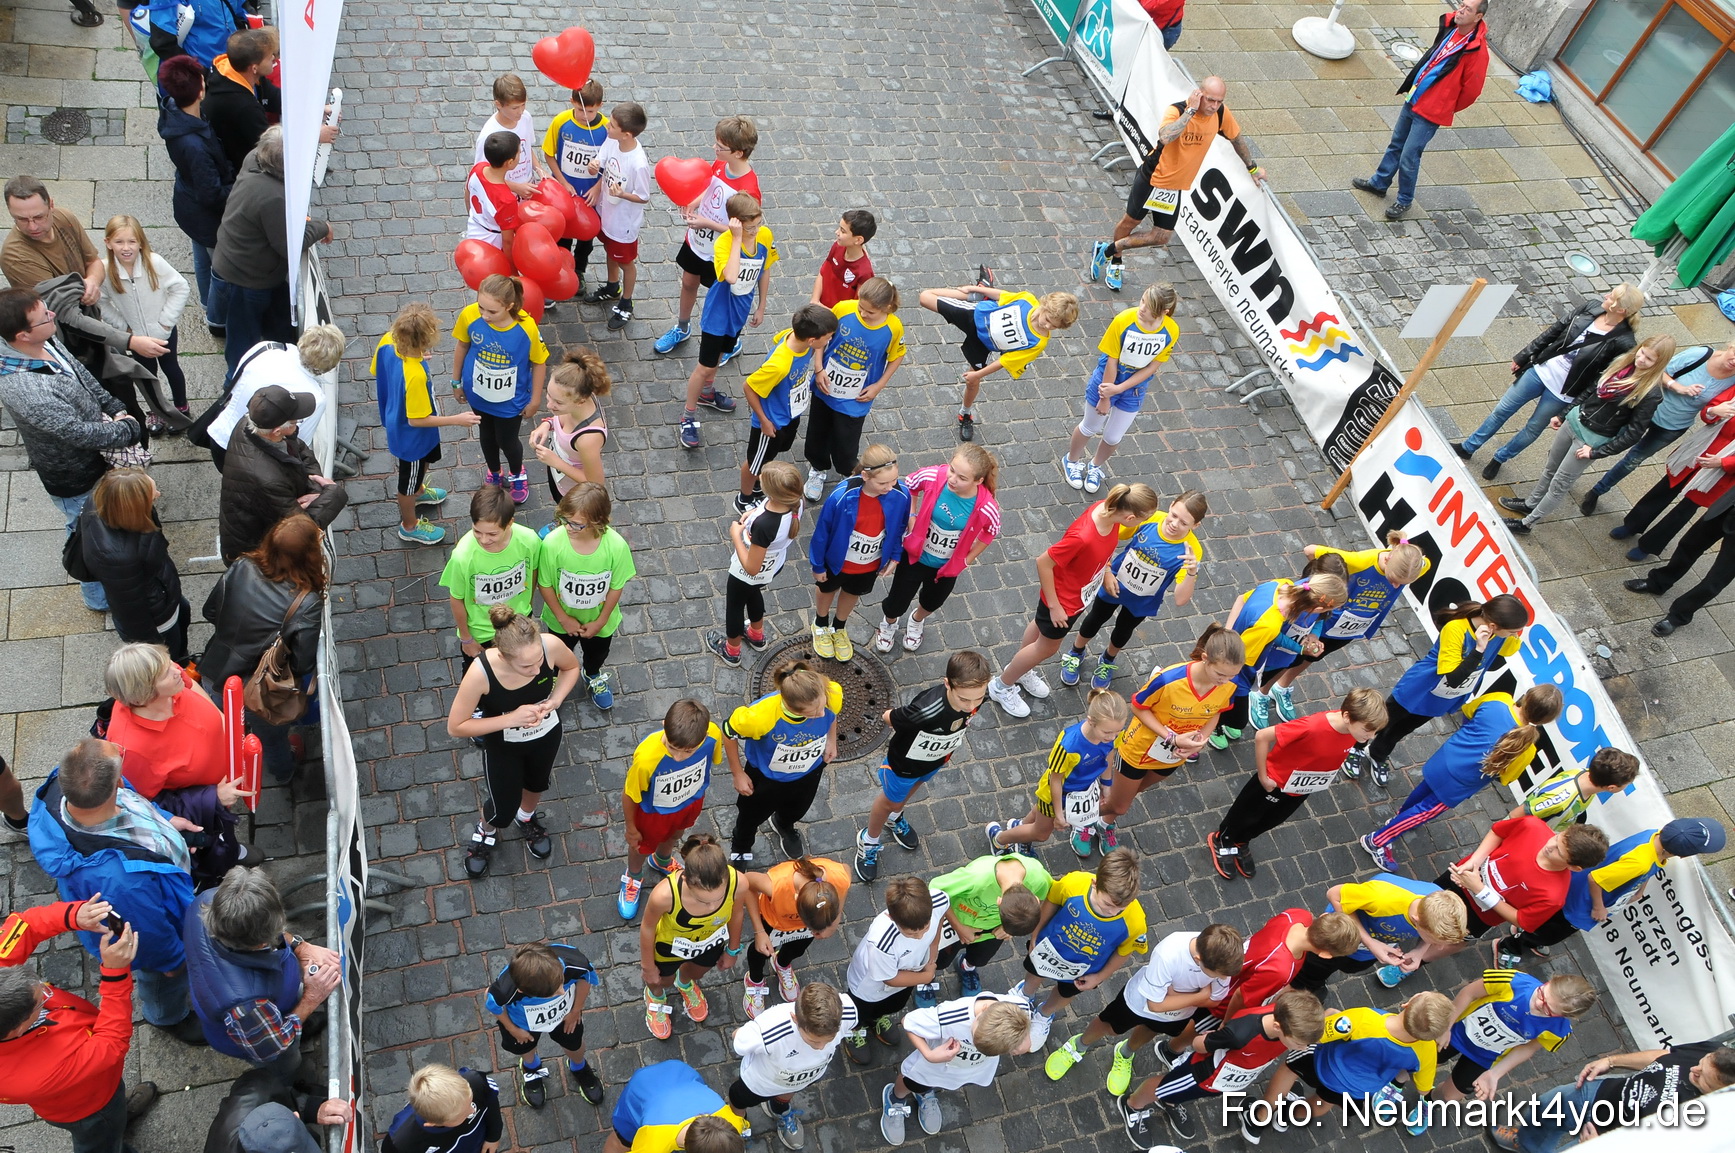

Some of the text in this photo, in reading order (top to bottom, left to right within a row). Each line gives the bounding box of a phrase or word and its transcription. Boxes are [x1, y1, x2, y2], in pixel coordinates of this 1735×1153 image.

[1155, 191, 1176, 203] 220
[1191, 168, 1295, 326] swn
[1179, 206, 1296, 384] stadtwerke neumarkt
[1000, 312, 1019, 345] 4101
[1126, 342, 1161, 356] 4102
[476, 373, 513, 391] 4104
[828, 369, 861, 388] 4022
[926, 528, 957, 549] 4045
[481, 571, 522, 595] 4038
[1124, 562, 1160, 587] 4017
[564, 581, 606, 596] 4039
[1127, 579, 1144, 592] Judith
[491, 591, 514, 601] Adrian
[918, 738, 960, 751] 4042
[778, 746, 822, 763] 4035
[661, 769, 702, 795] 4053
[1291, 776, 1330, 787] 4025
[672, 790, 691, 803] David
[1624, 905, 1661, 967] Stadt
[1038, 952, 1081, 976] 4023
[1039, 964, 1064, 979] Jannick
